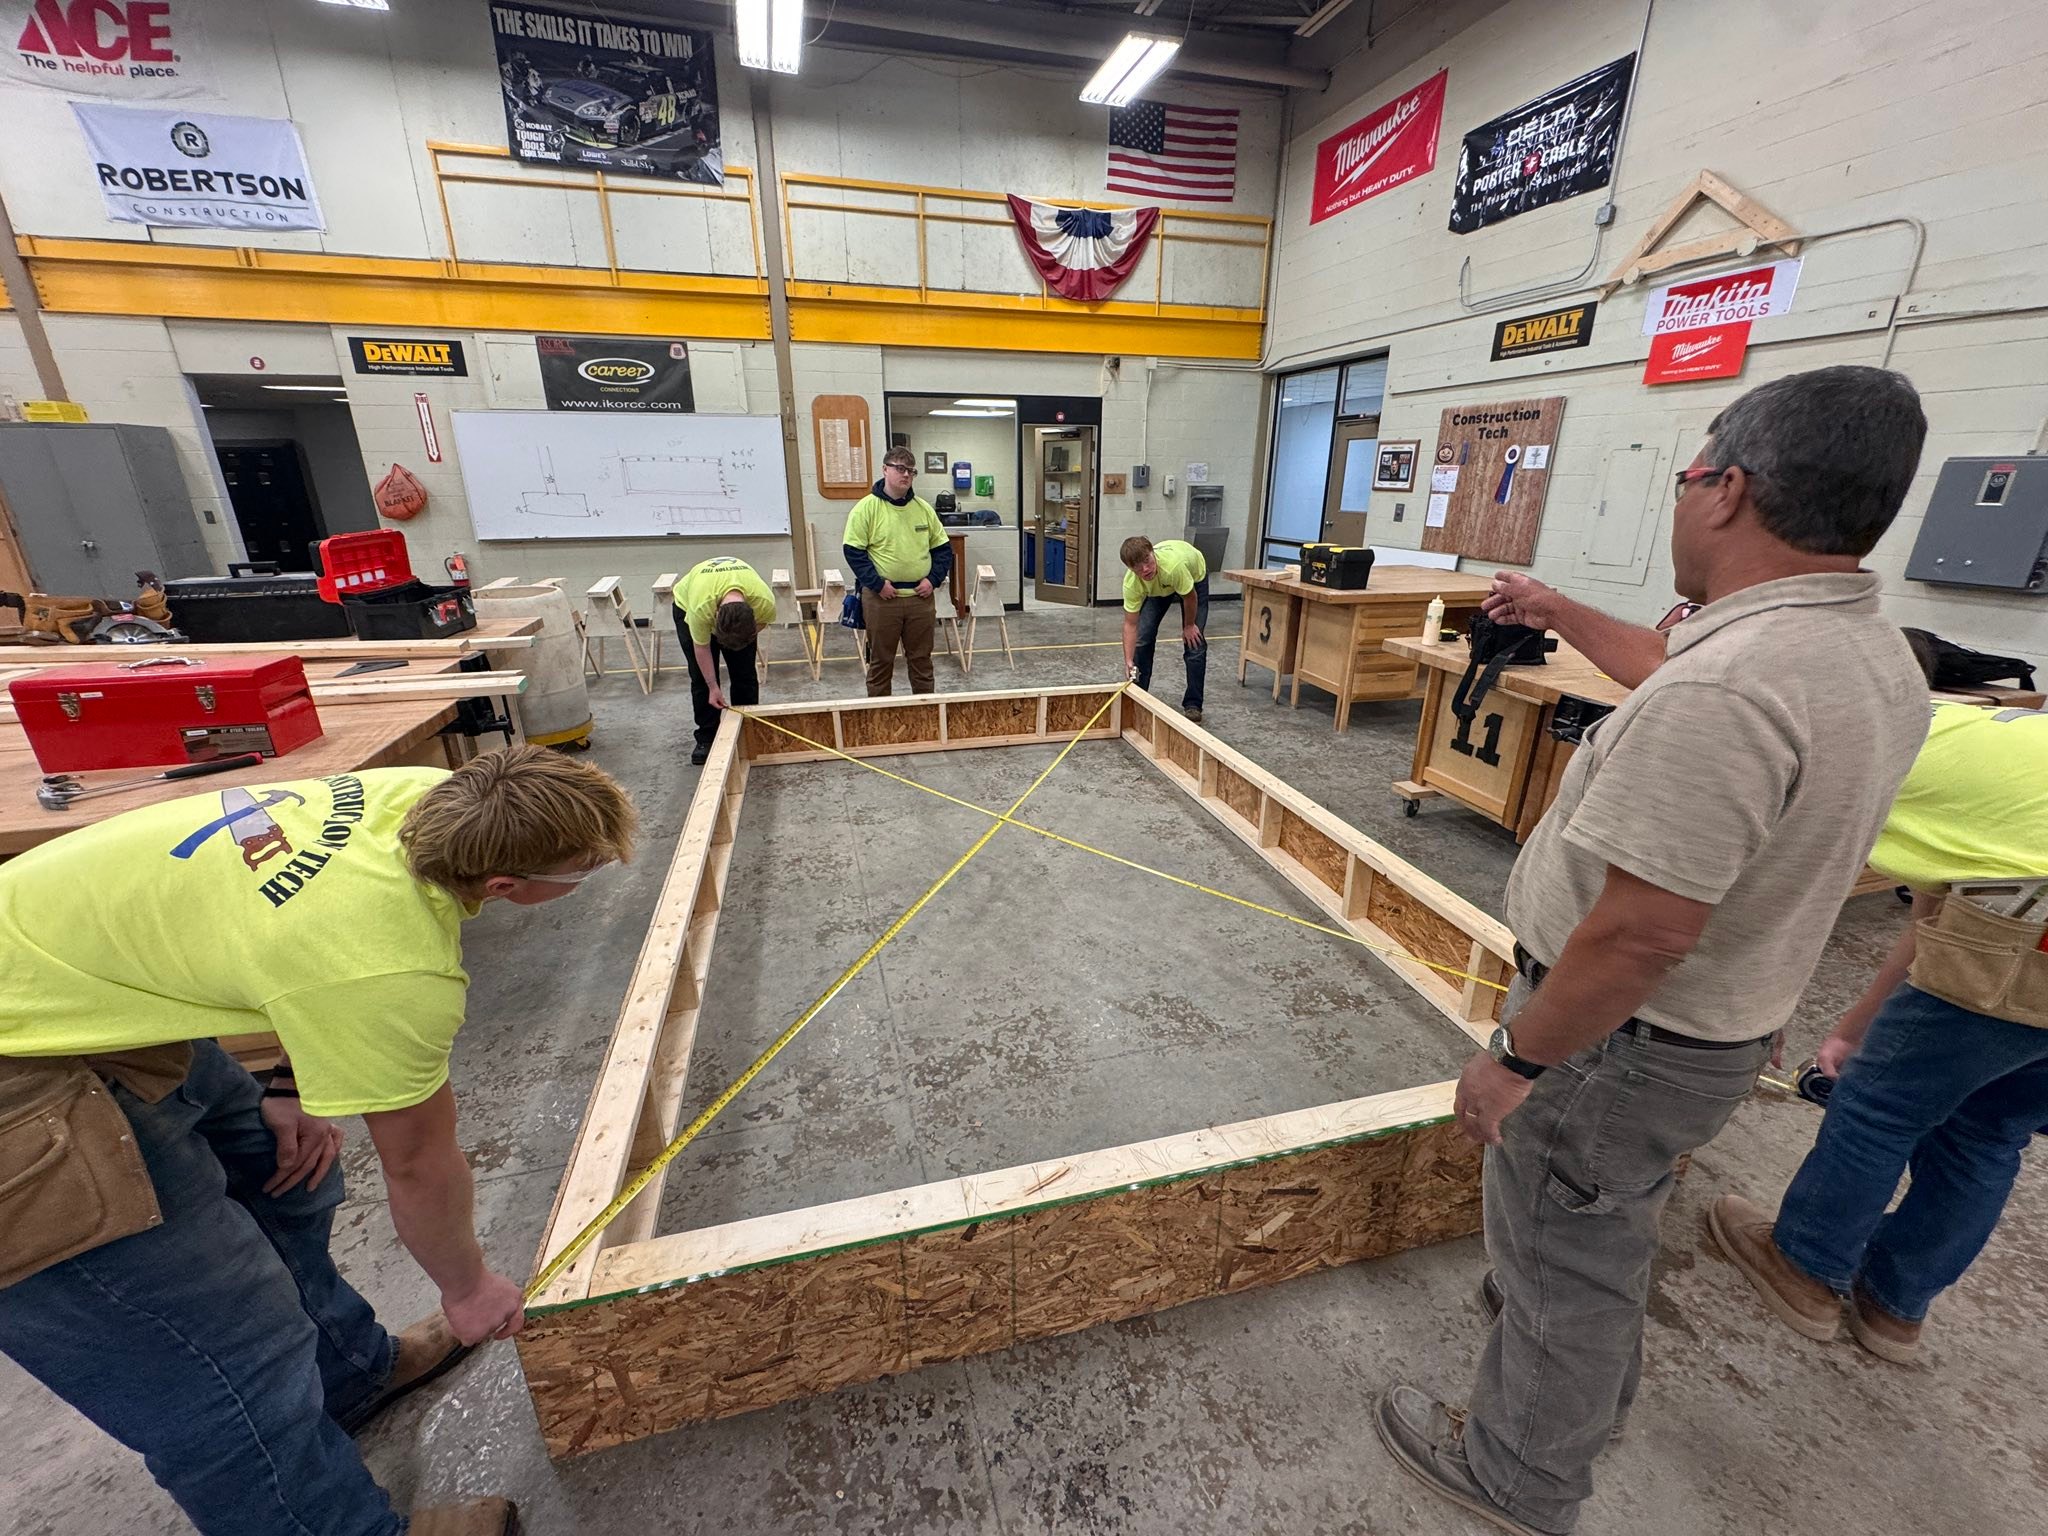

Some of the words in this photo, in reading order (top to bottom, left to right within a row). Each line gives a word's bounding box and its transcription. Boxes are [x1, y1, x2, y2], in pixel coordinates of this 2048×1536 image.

[17, 0, 174, 62] ACE
[492, 7, 525, 37] THE
[524, 12, 577, 44] SKILLS
[577, 19, 592, 46] IT
[593, 22, 641, 53] TAKES
[640, 28, 660, 56] TO
[661, 31, 694, 59] WIN
[20, 53, 58, 70] The
[63, 59, 126, 77] helpful
[130, 64, 179, 78] place.
[658, 94, 676, 126] 48
[515, 129, 545, 142] TOUGH
[525, 121, 553, 131] KOBALT
[1506, 103, 1578, 147] DELTA
[184, 133, 198, 147] R
[521, 140, 546, 151] TOOLS
[1332, 94, 1421, 182] Milwaukee
[1472, 162, 1522, 196] PORTER
[1540, 134, 1590, 168] CABLE
[96, 162, 307, 201] ROBERTSON
[1349, 190, 1361, 202] but
[1361, 177, 1388, 196] HEAVY
[133, 203, 289, 223] CONSTRUCTION
[1656, 311, 1710, 332] POWER
[1716, 302, 1770, 323] TOOLS
[1672, 334, 1723, 360] Milwaukee
[587, 364, 647, 377] career
[600, 386, 640, 394] CONNECTIONS
[561, 399, 682, 410] www.ikorcc.com
[1452, 407, 1541, 426] Construction
[1478, 426, 1509, 440] Tech
[1259, 606, 1272, 644] 3
[1450, 708, 1504, 767] 11
[258, 849, 332, 908] TECH
